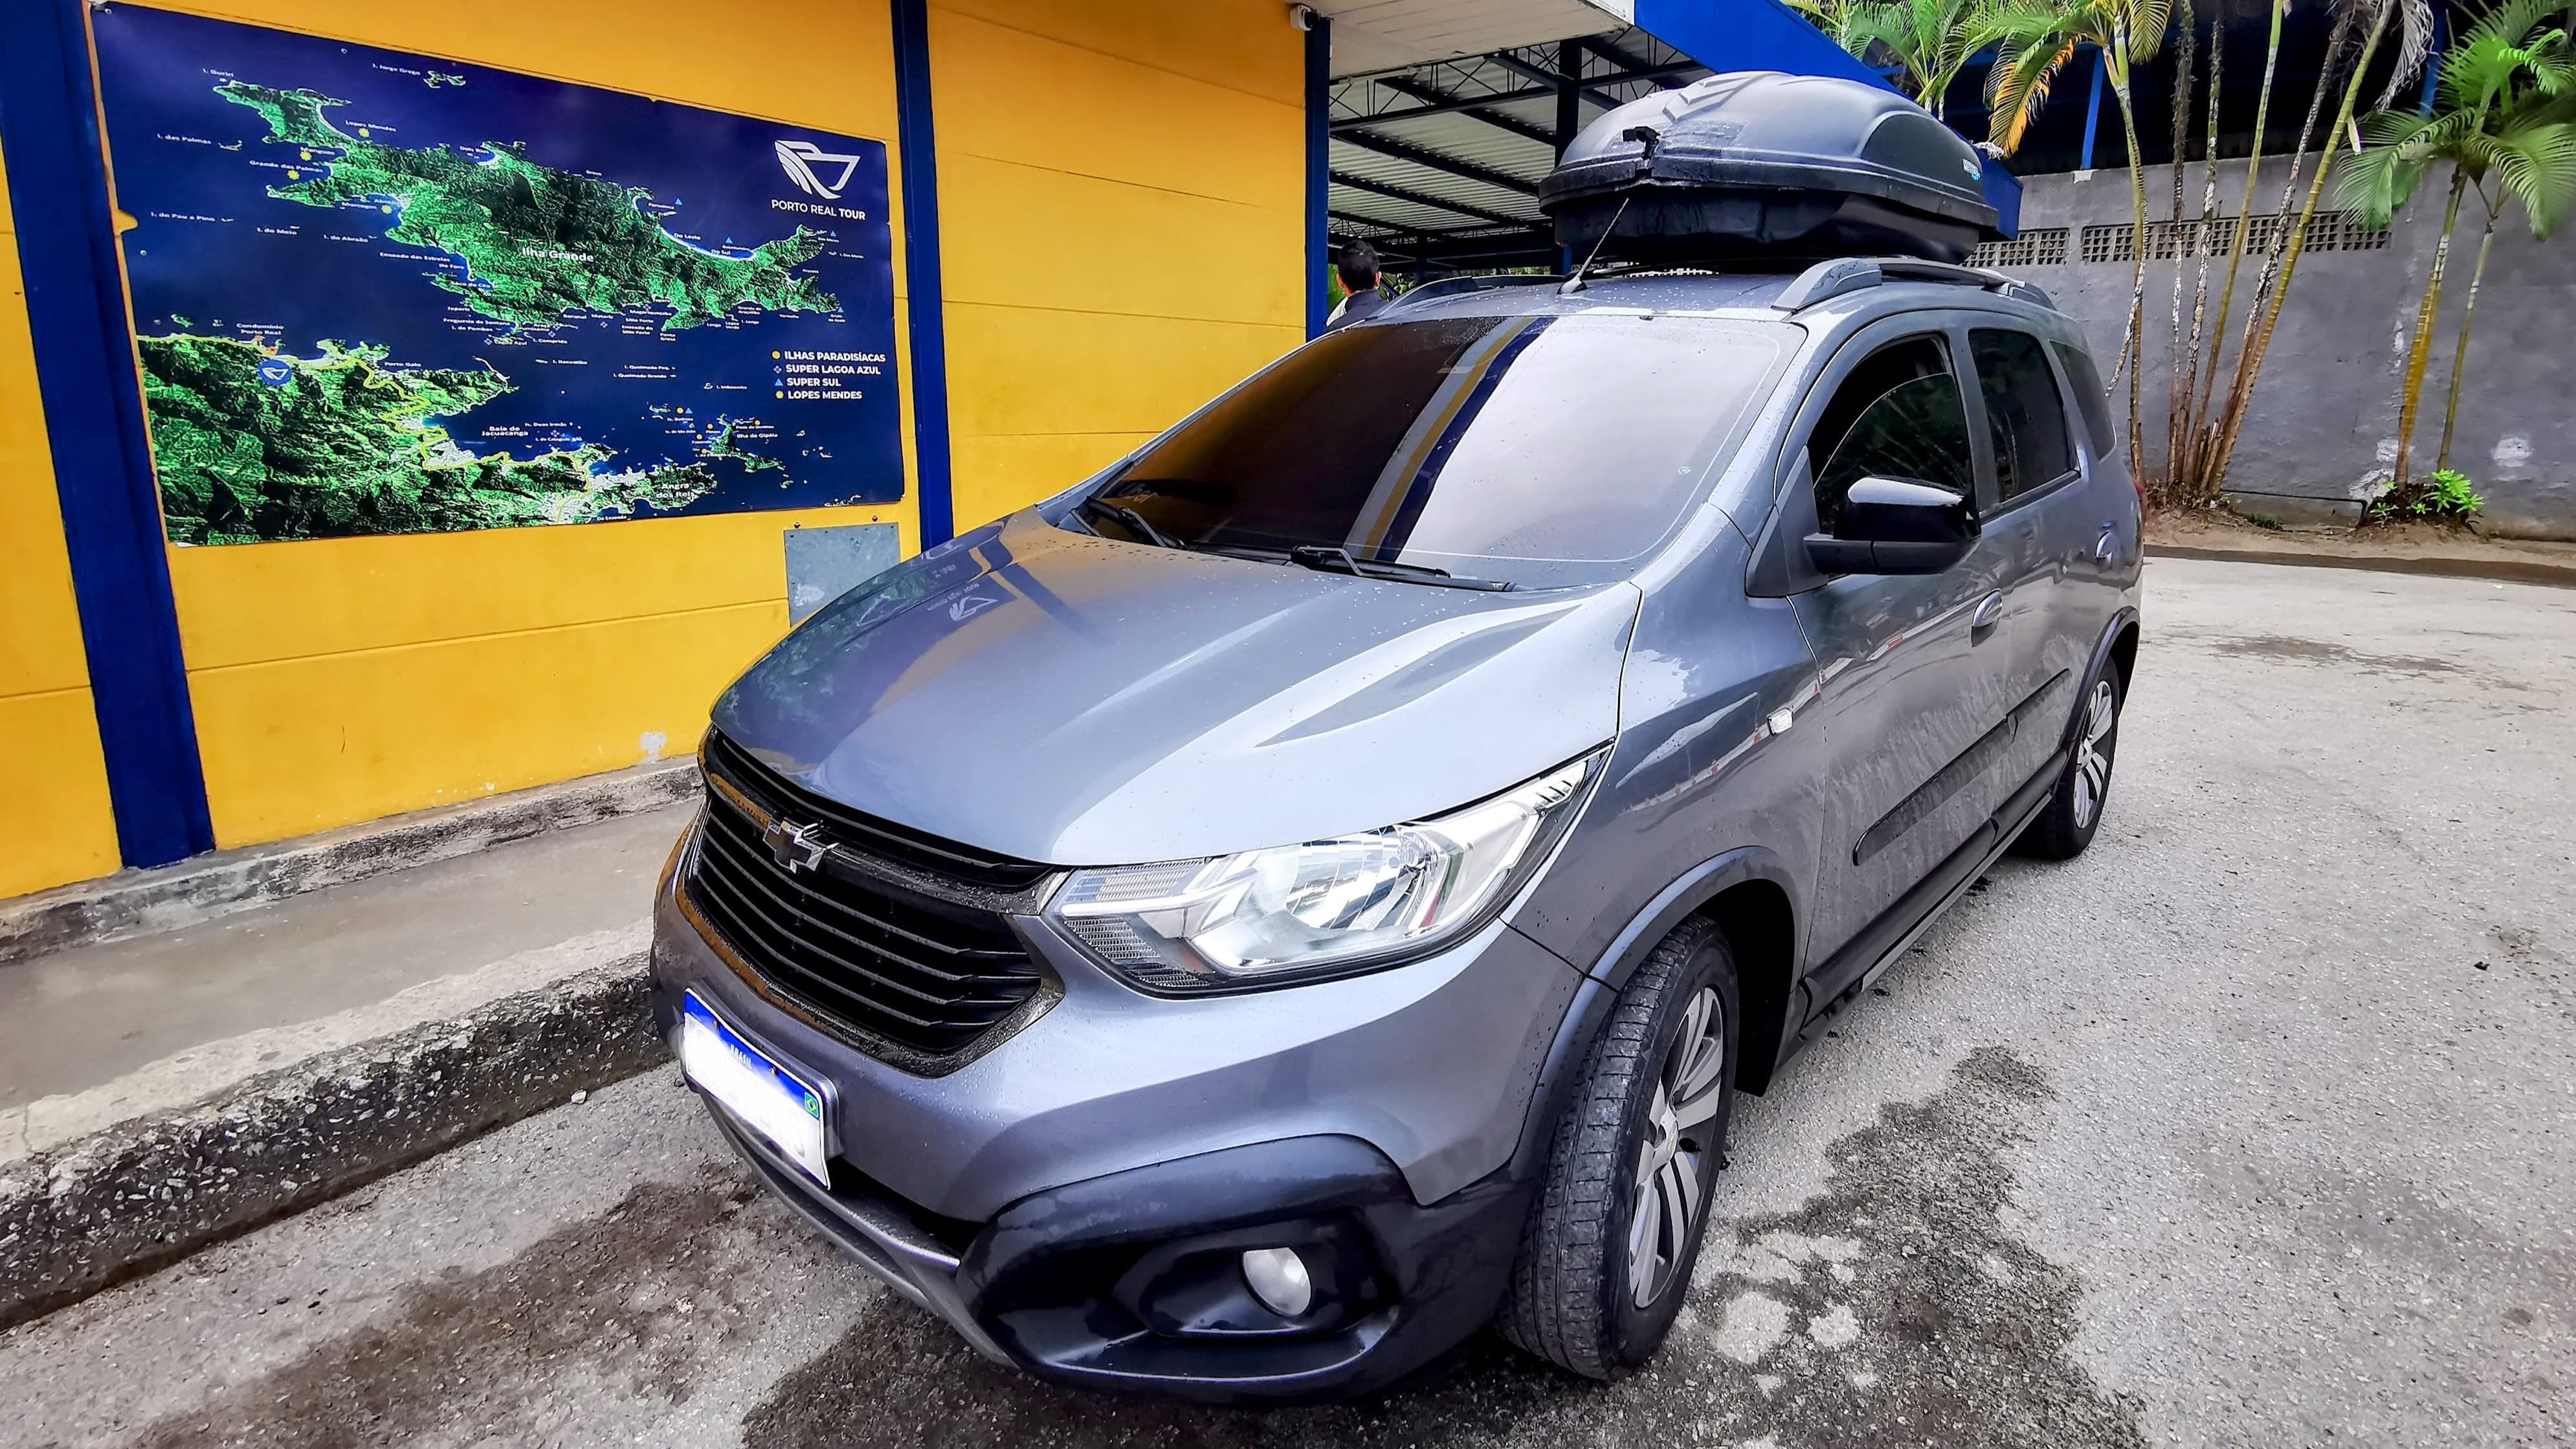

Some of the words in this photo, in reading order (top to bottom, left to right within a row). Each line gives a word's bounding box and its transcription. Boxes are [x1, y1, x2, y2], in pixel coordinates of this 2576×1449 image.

[368, 123, 396, 132] Mendes
[771, 199, 808, 212] PORTO
[810, 204, 837, 216] REAL
[838, 208, 865, 220] TOUR
[522, 247, 545, 257] Ilha
[549, 250, 594, 262] Grande
[784, 351, 815, 360] ILHAS
[817, 352, 886, 362] PARADISÍACAS
[786, 364, 819, 373] SUPER
[821, 365, 855, 374] LAGOA
[856, 366, 881, 375] AZUL
[786, 377, 820, 387] SUPER
[822, 378, 841, 387] SUL
[788, 390, 820, 399] LOPES
[822, 391, 862, 399] MENDES
[730, 1044, 752, 1068] BRASIL
